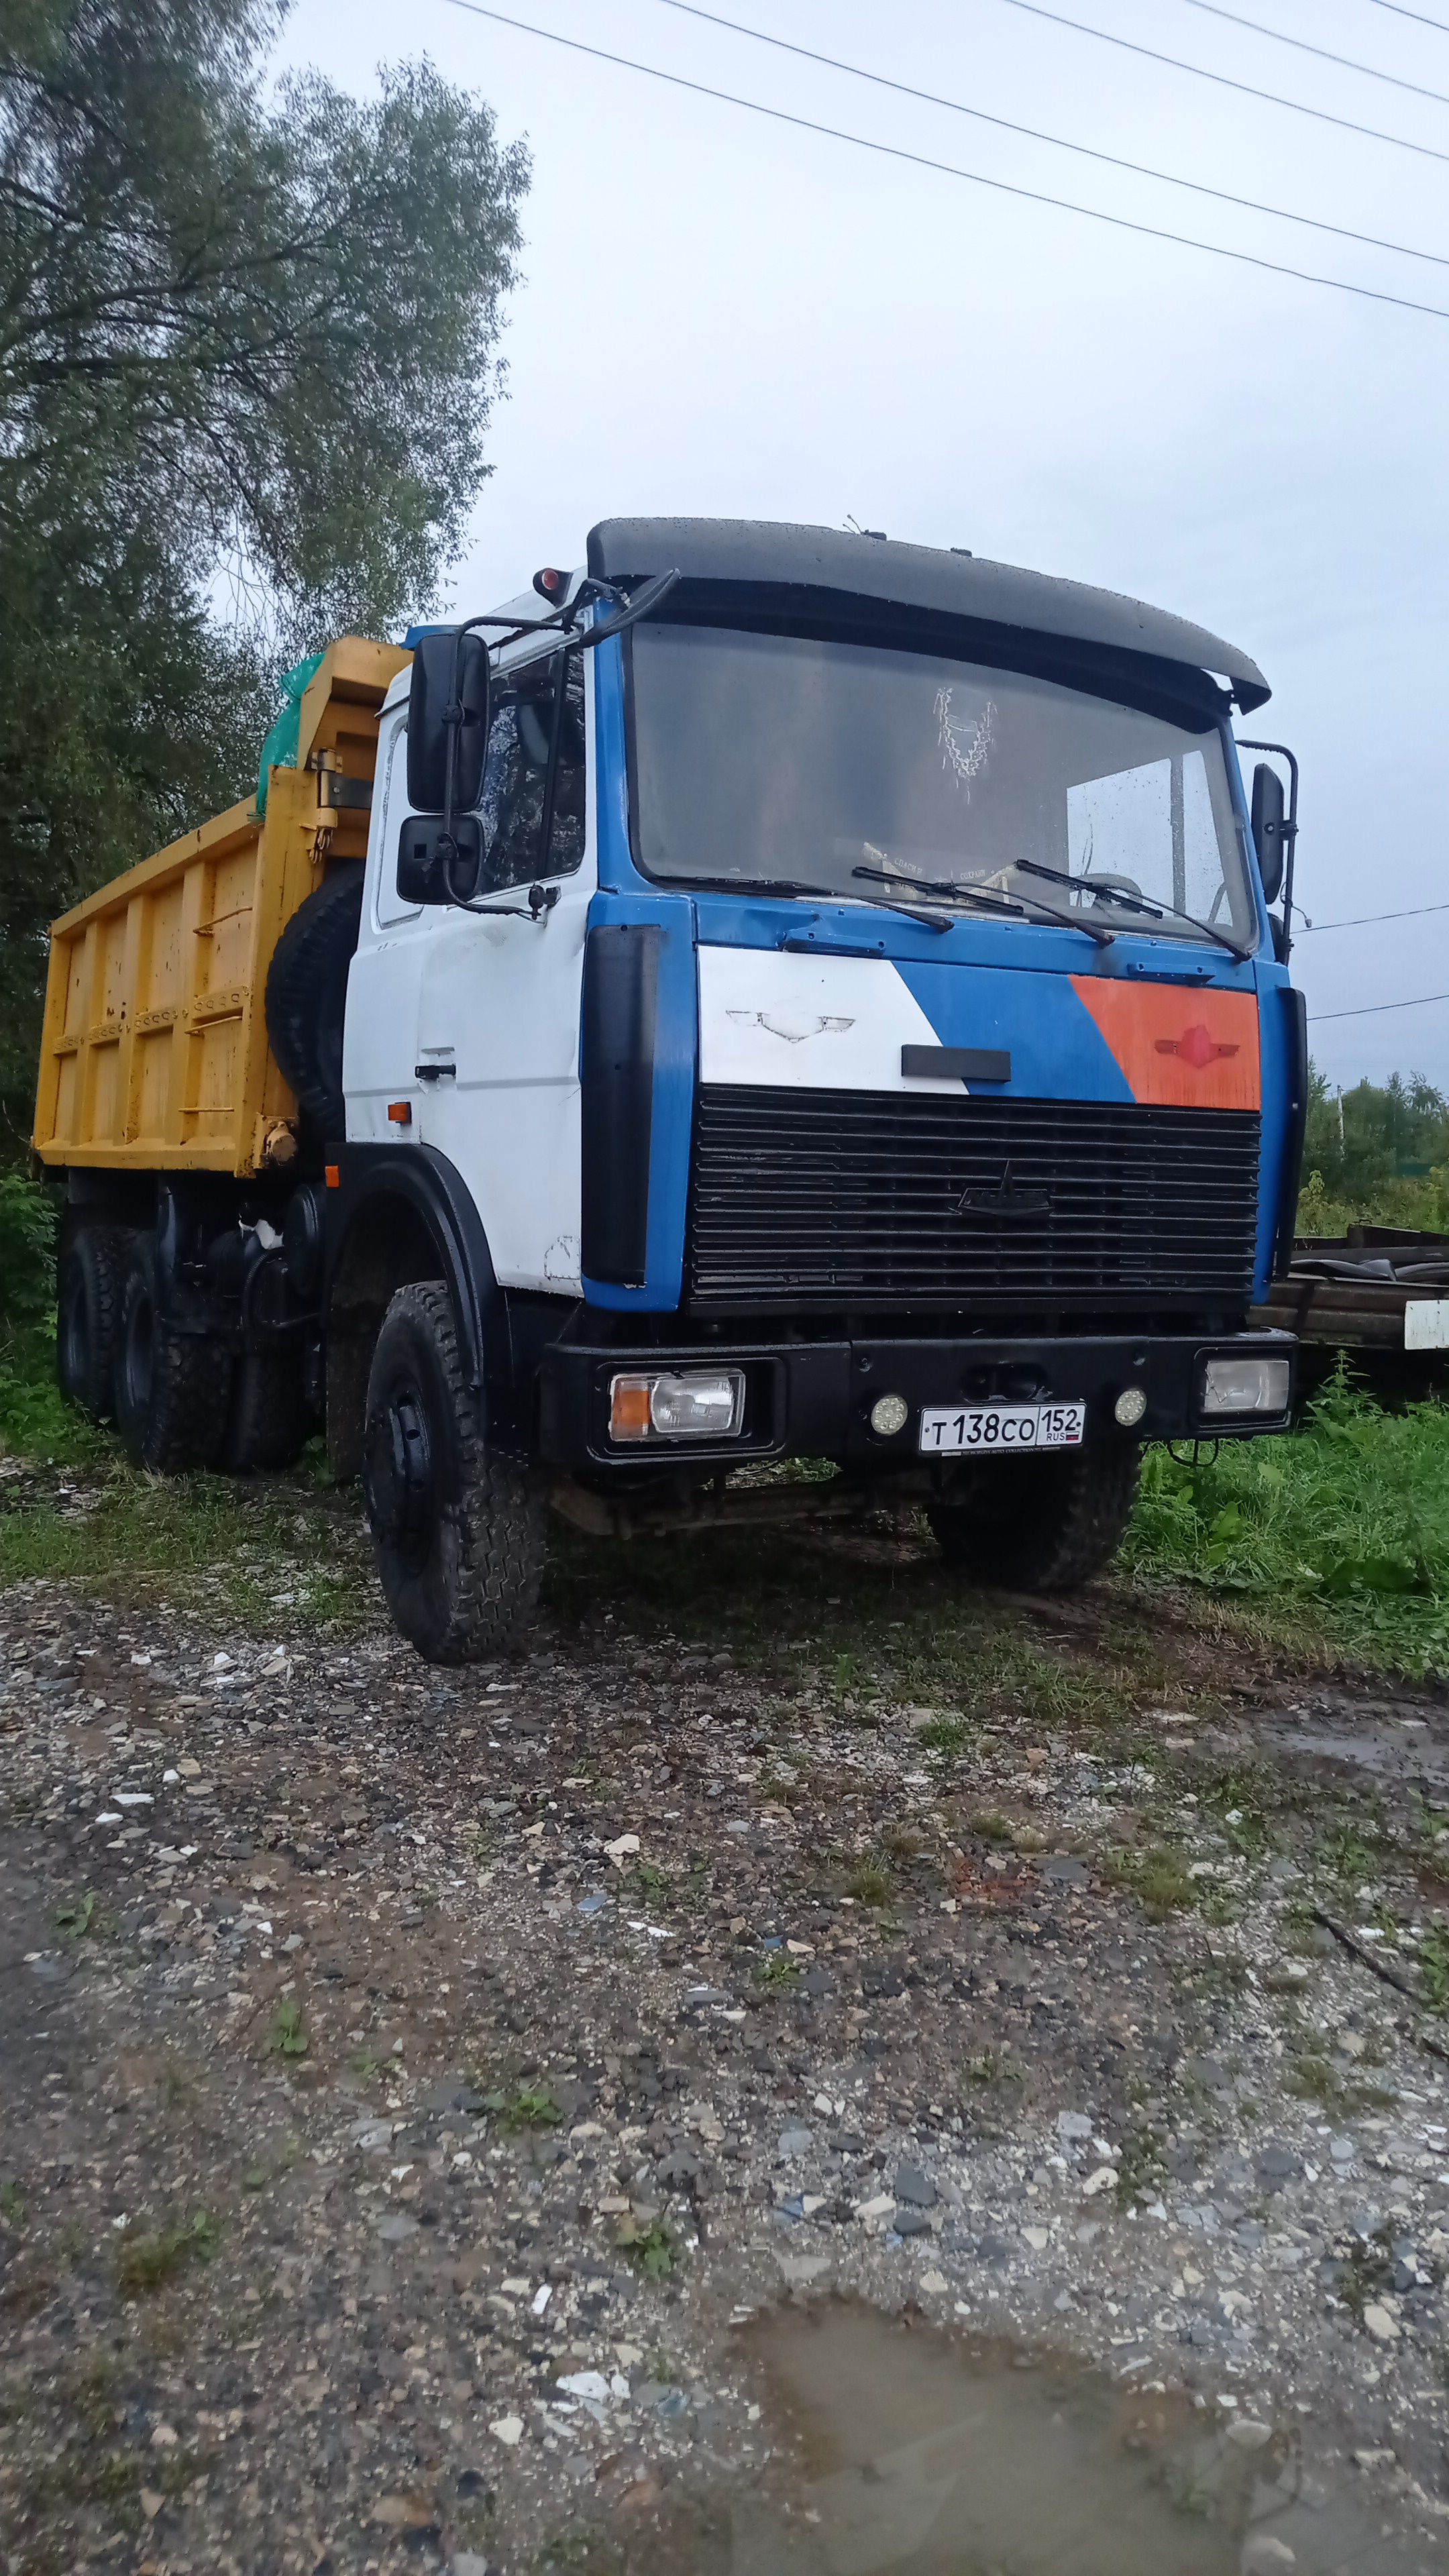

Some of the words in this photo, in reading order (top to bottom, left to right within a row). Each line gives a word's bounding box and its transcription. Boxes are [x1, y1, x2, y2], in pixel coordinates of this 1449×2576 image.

[894, 857, 916, 873] СПАСИ
[1041, 1409, 1077, 1432] 152
[1046, 1432, 1065, 1441] RUS
